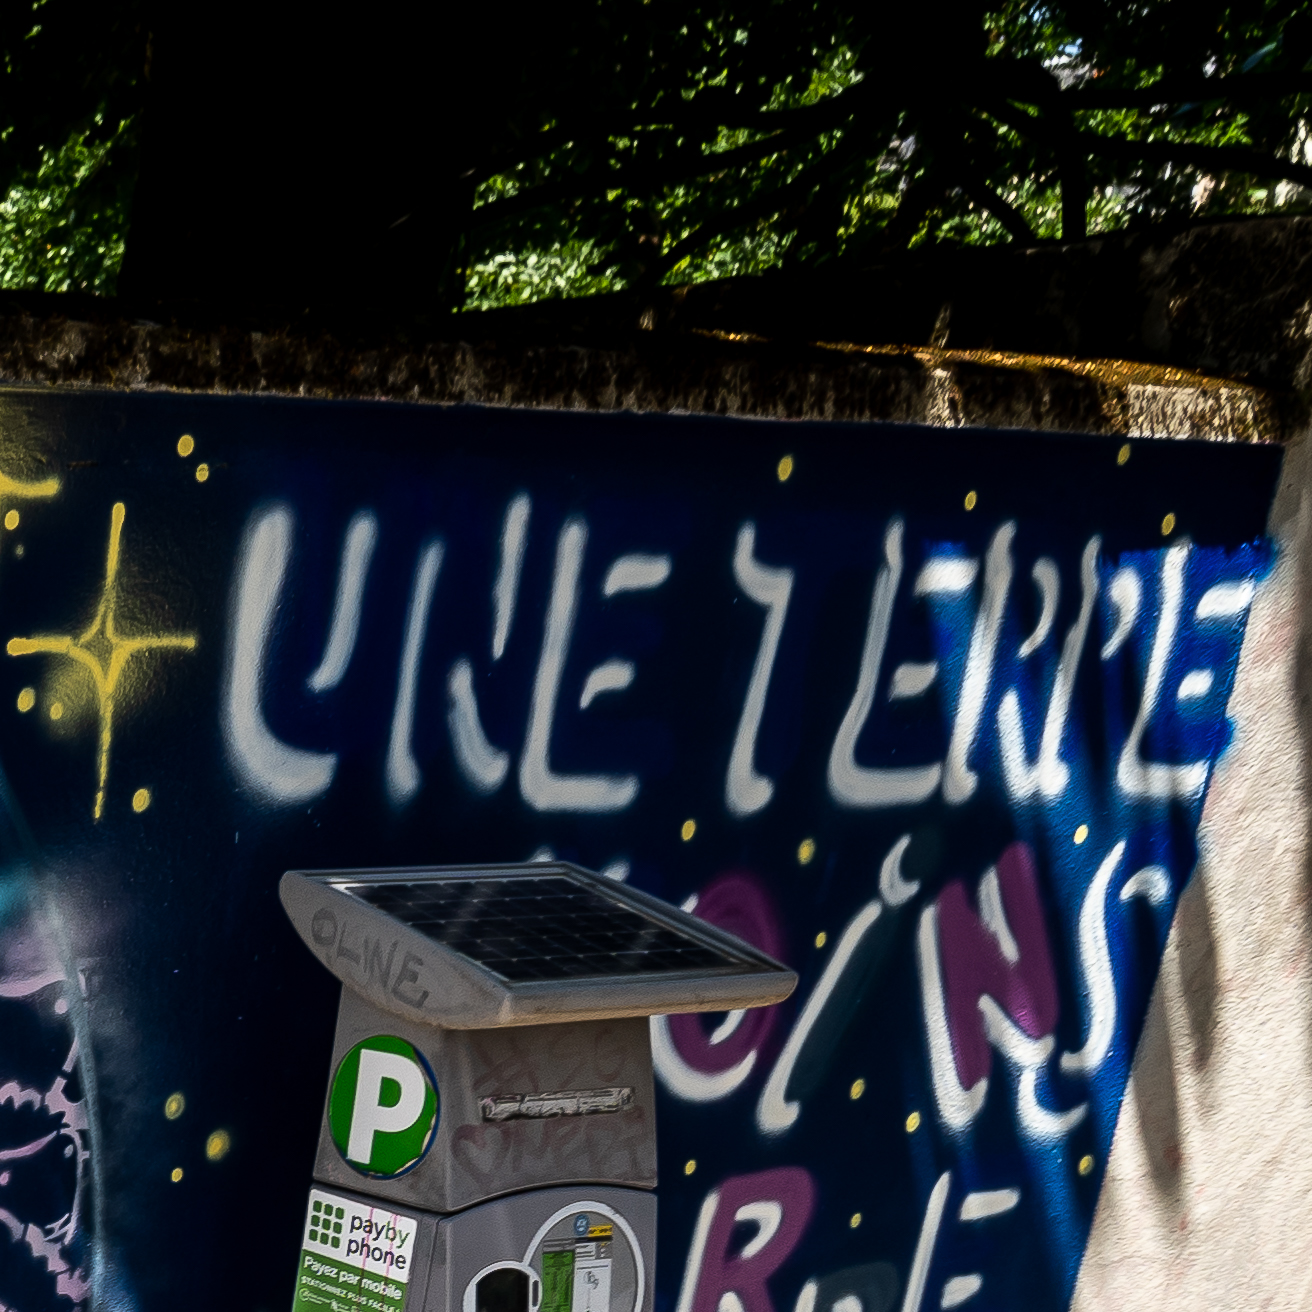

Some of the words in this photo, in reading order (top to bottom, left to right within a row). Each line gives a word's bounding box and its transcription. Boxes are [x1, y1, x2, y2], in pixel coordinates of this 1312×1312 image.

[224, 492, 672, 812] UNE
[726, 518, 1255, 816] TERRE
[529, 843, 1172, 1141] OINS
[346, 1048, 426, 1165] P
[346, 1238, 407, 1270] phone
[349, 1215, 410, 1250] payby
[361, 1277, 403, 1300] mobile
